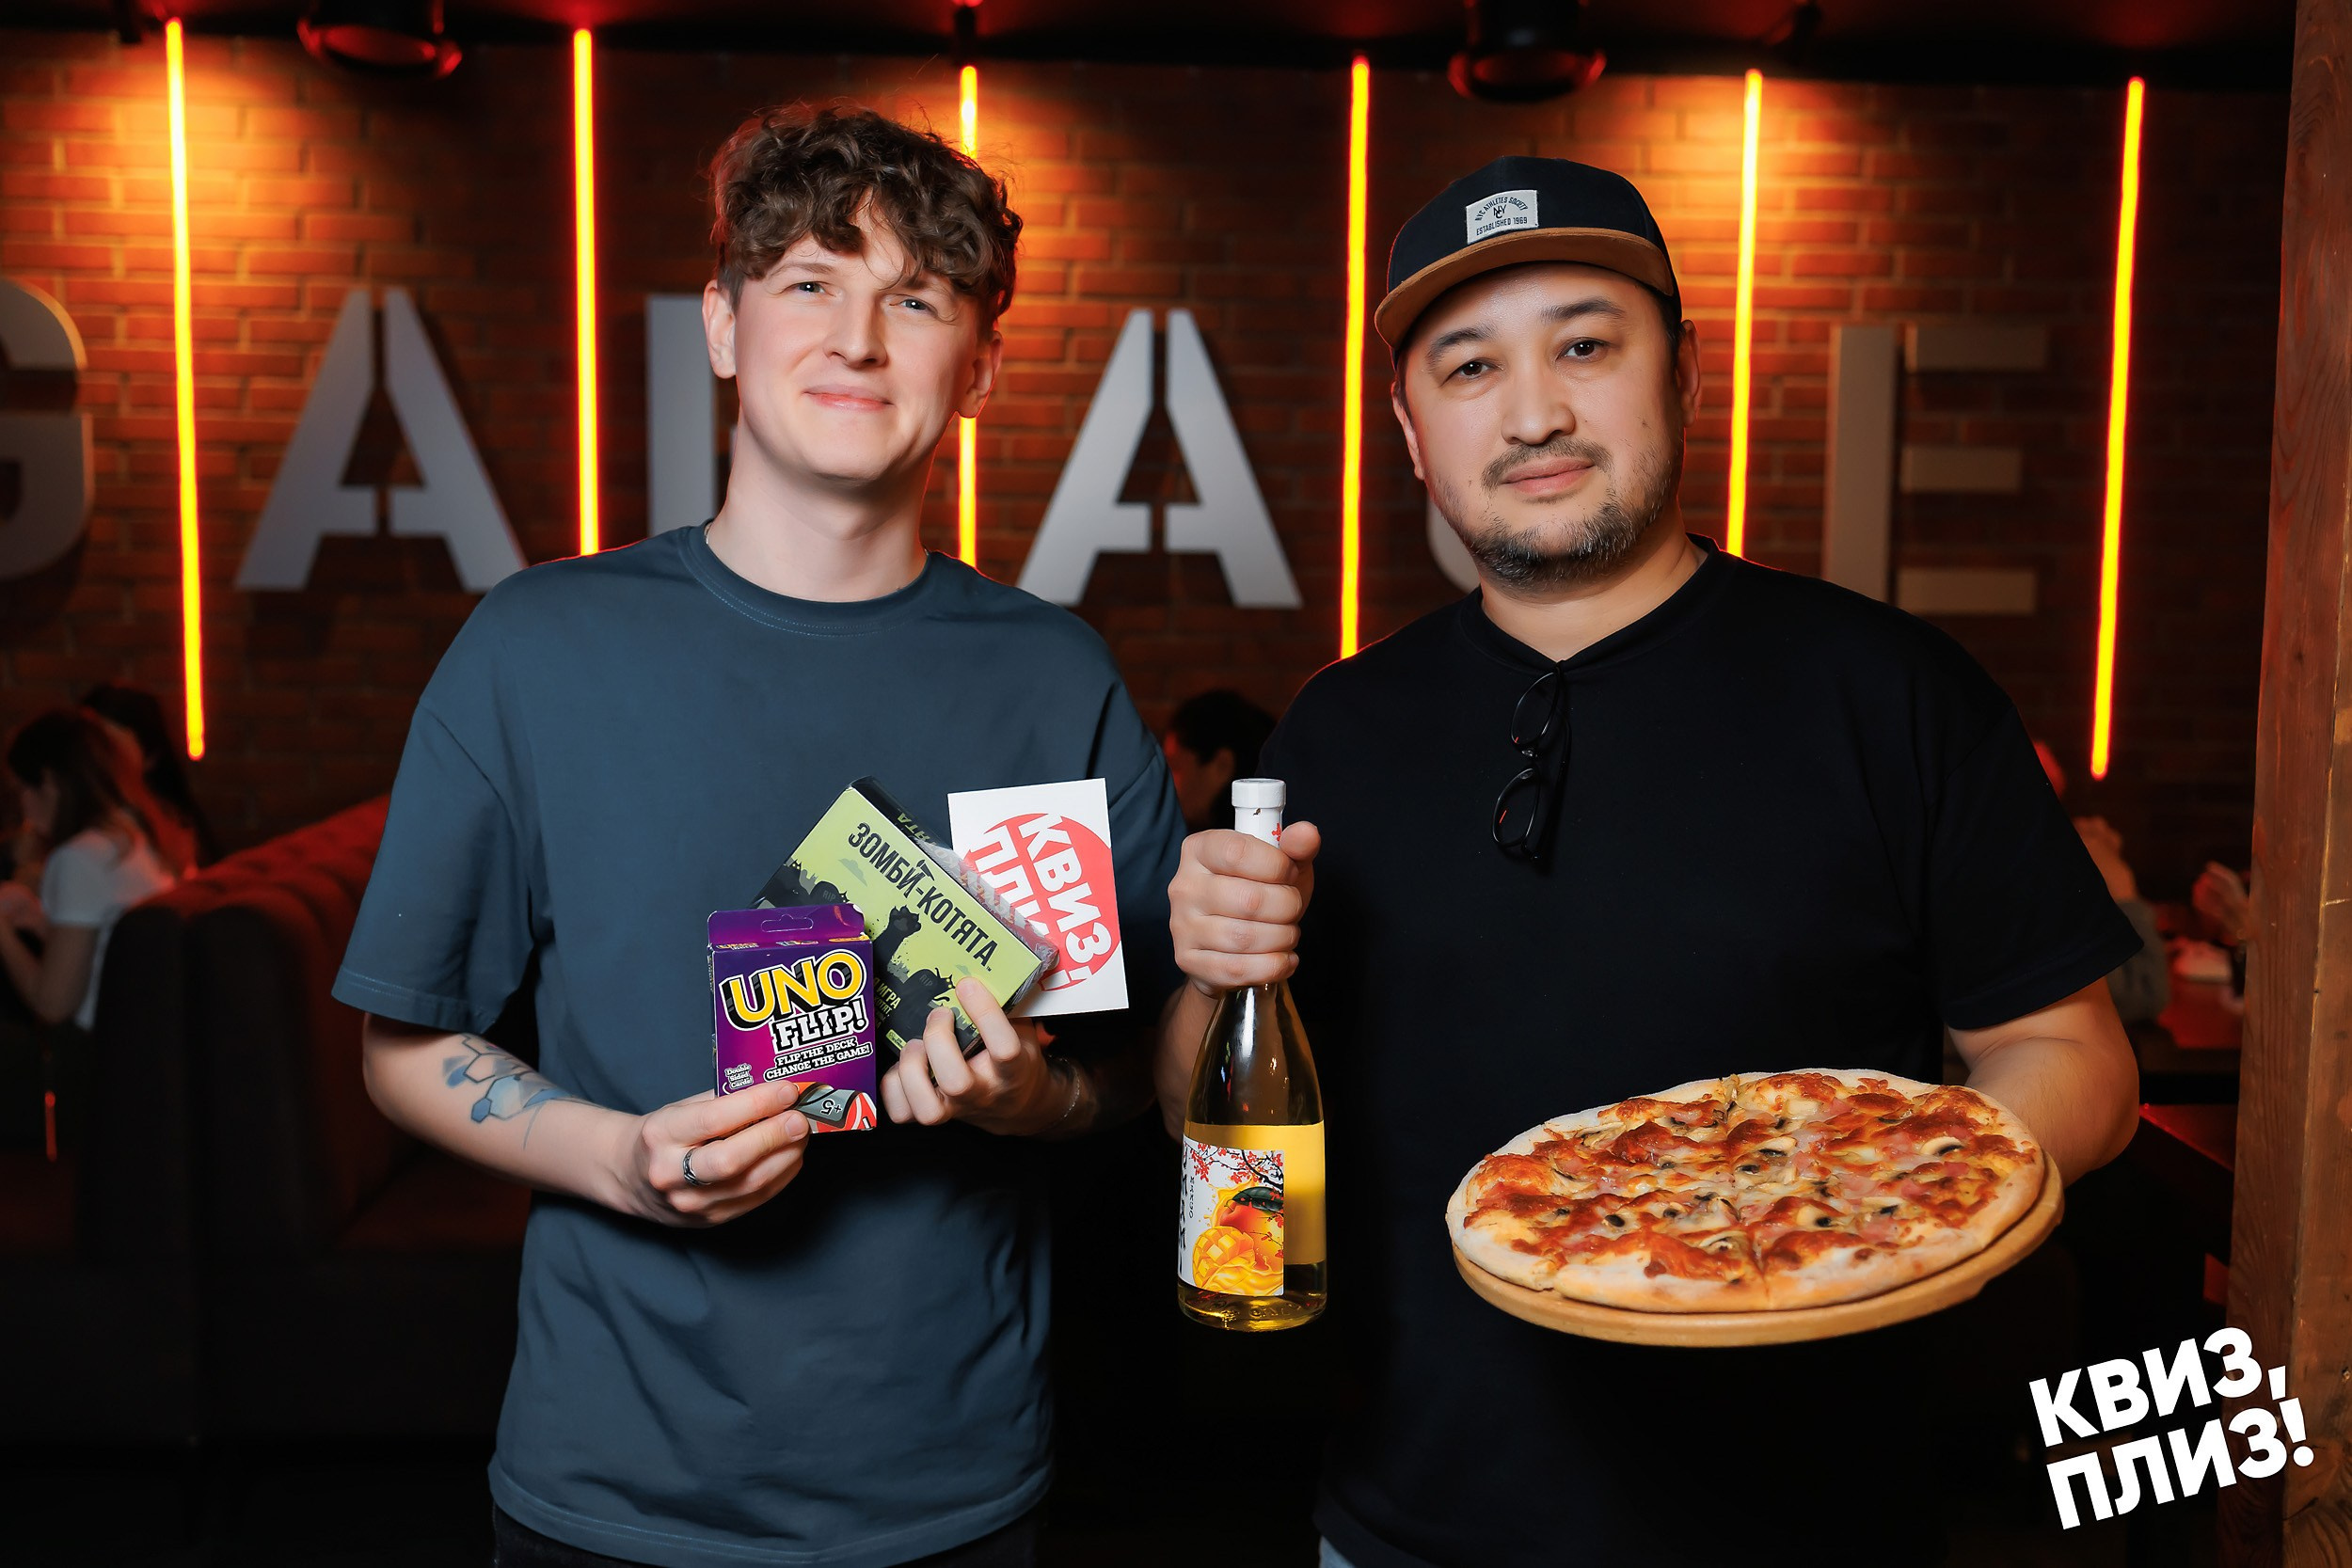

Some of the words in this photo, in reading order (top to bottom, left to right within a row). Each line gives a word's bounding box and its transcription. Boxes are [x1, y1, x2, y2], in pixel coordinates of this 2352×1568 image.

[1485, 197, 1508, 212] ATHLETES
[1476, 217, 1512, 236] ESTABLISHED
[1513, 216, 1528, 225] 1969
[822, 890, 836, 901] RIP
[848, 822, 998, 967] ЗОМБИ-КОТЯТА
[722, 950, 866, 1028] UNO
[877, 983, 901, 1009] ИГРА
[774, 1001, 866, 1049] FLIP!
[766, 1061, 812, 1079] CHANGE
[812, 1053, 835, 1067] THE
[835, 1045, 870, 1060] GAME!
[776, 1053, 802, 1066] FLIP
[801, 1046, 824, 1059] THE
[826, 1037, 856, 1053] DECK
